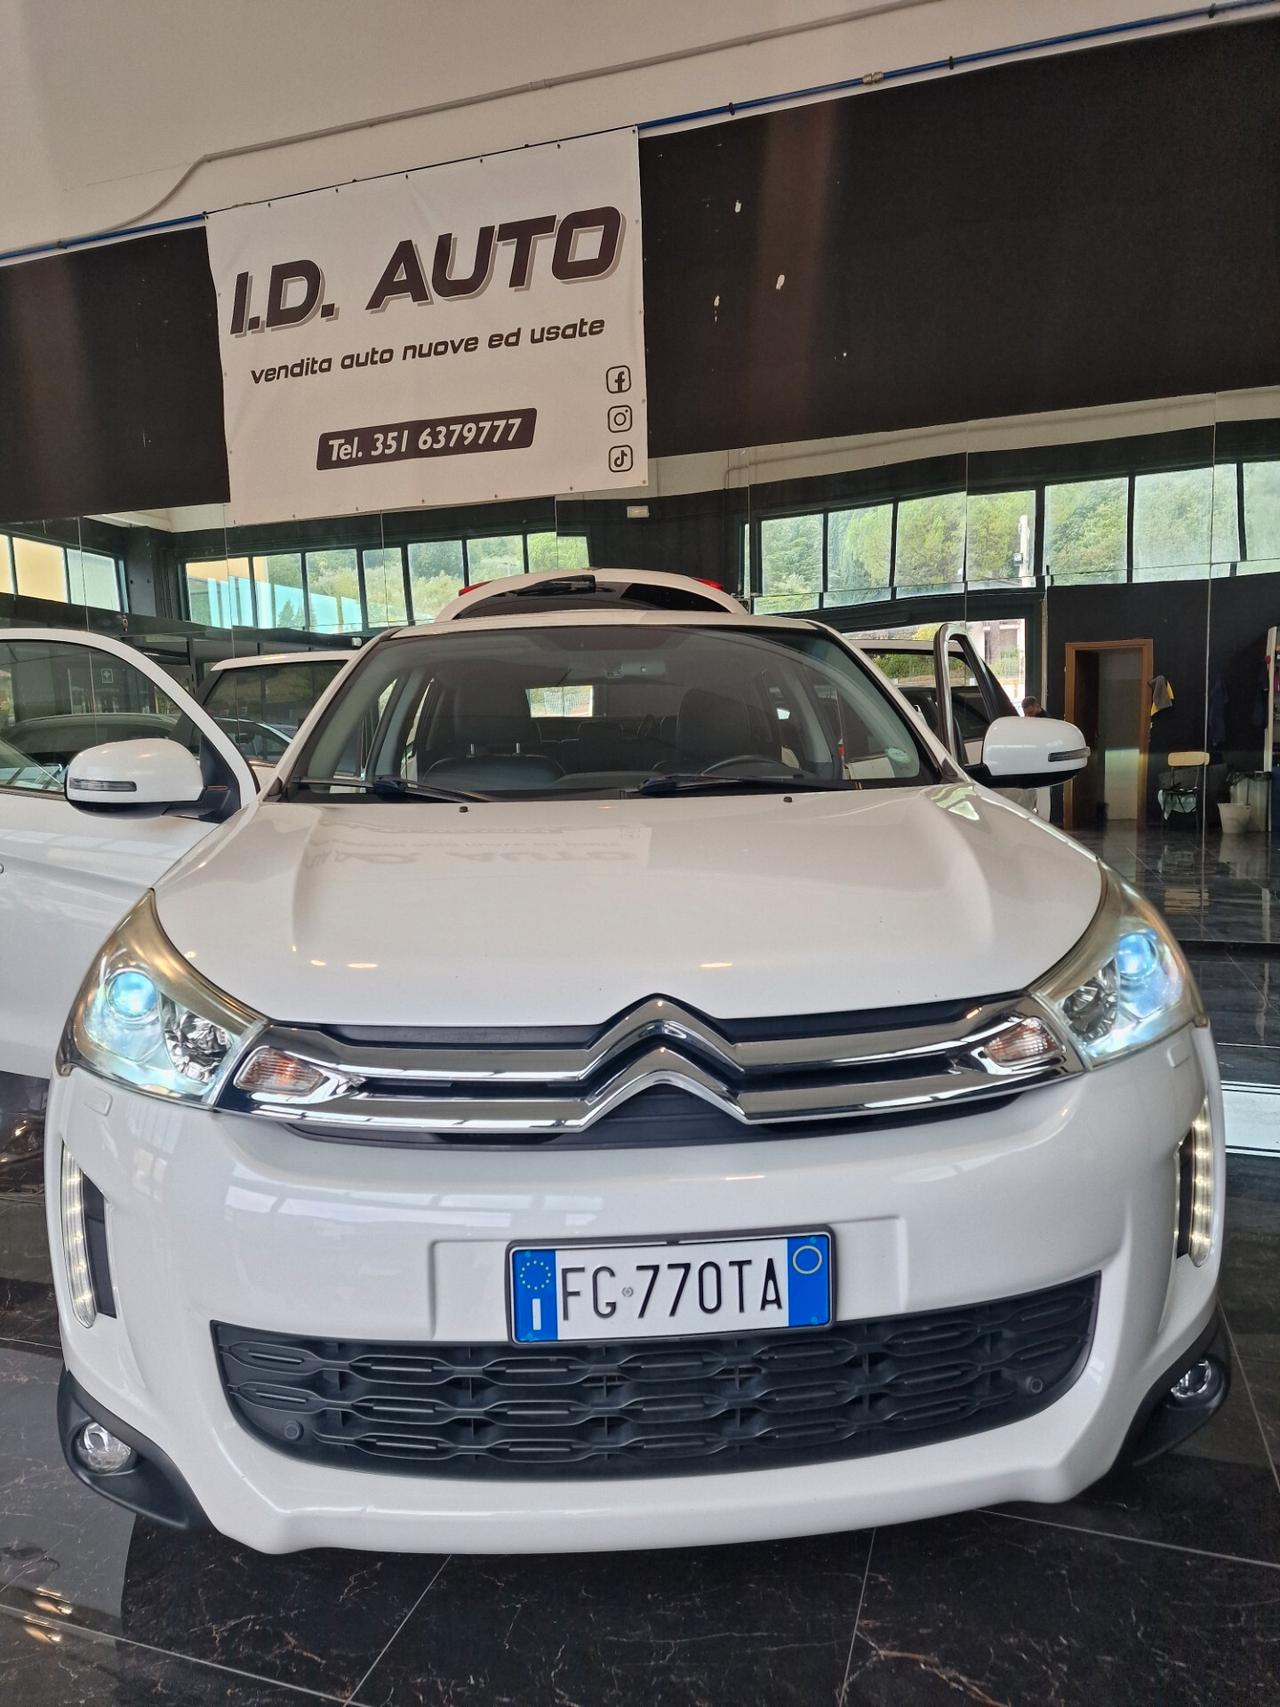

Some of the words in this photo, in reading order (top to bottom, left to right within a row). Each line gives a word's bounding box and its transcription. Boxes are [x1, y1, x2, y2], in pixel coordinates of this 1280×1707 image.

[230, 259, 340, 338] I.D.
[365, 206, 627, 314] AUTO
[250, 356, 332, 384] vendita
[340, 347, 394, 370] auto
[402, 336, 479, 361] nuove
[488, 327, 521, 348] ed
[530, 317, 605, 344] usate
[328, 439, 363, 462] Tel.
[370, 431, 409, 457] 351
[418, 417, 523, 450] 6379777
